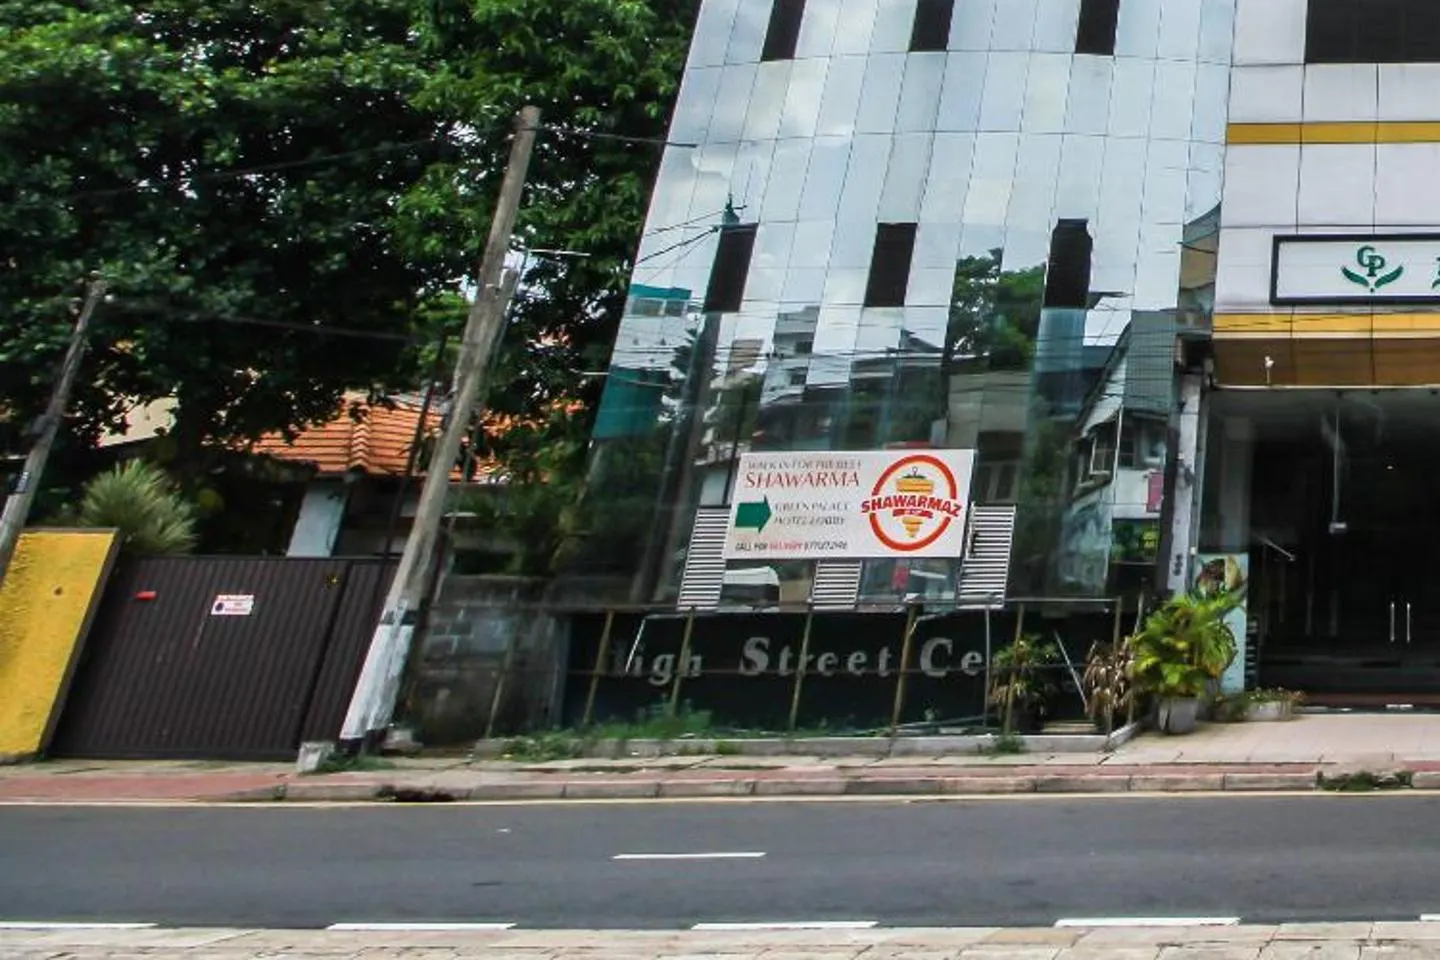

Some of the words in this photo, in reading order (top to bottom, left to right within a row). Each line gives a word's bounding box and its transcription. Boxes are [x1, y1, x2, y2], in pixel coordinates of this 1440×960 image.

[744, 471, 860, 488] SHAWARMA
[861, 494, 962, 517] SHAWARMAZ
[738, 637, 893, 677] Street
